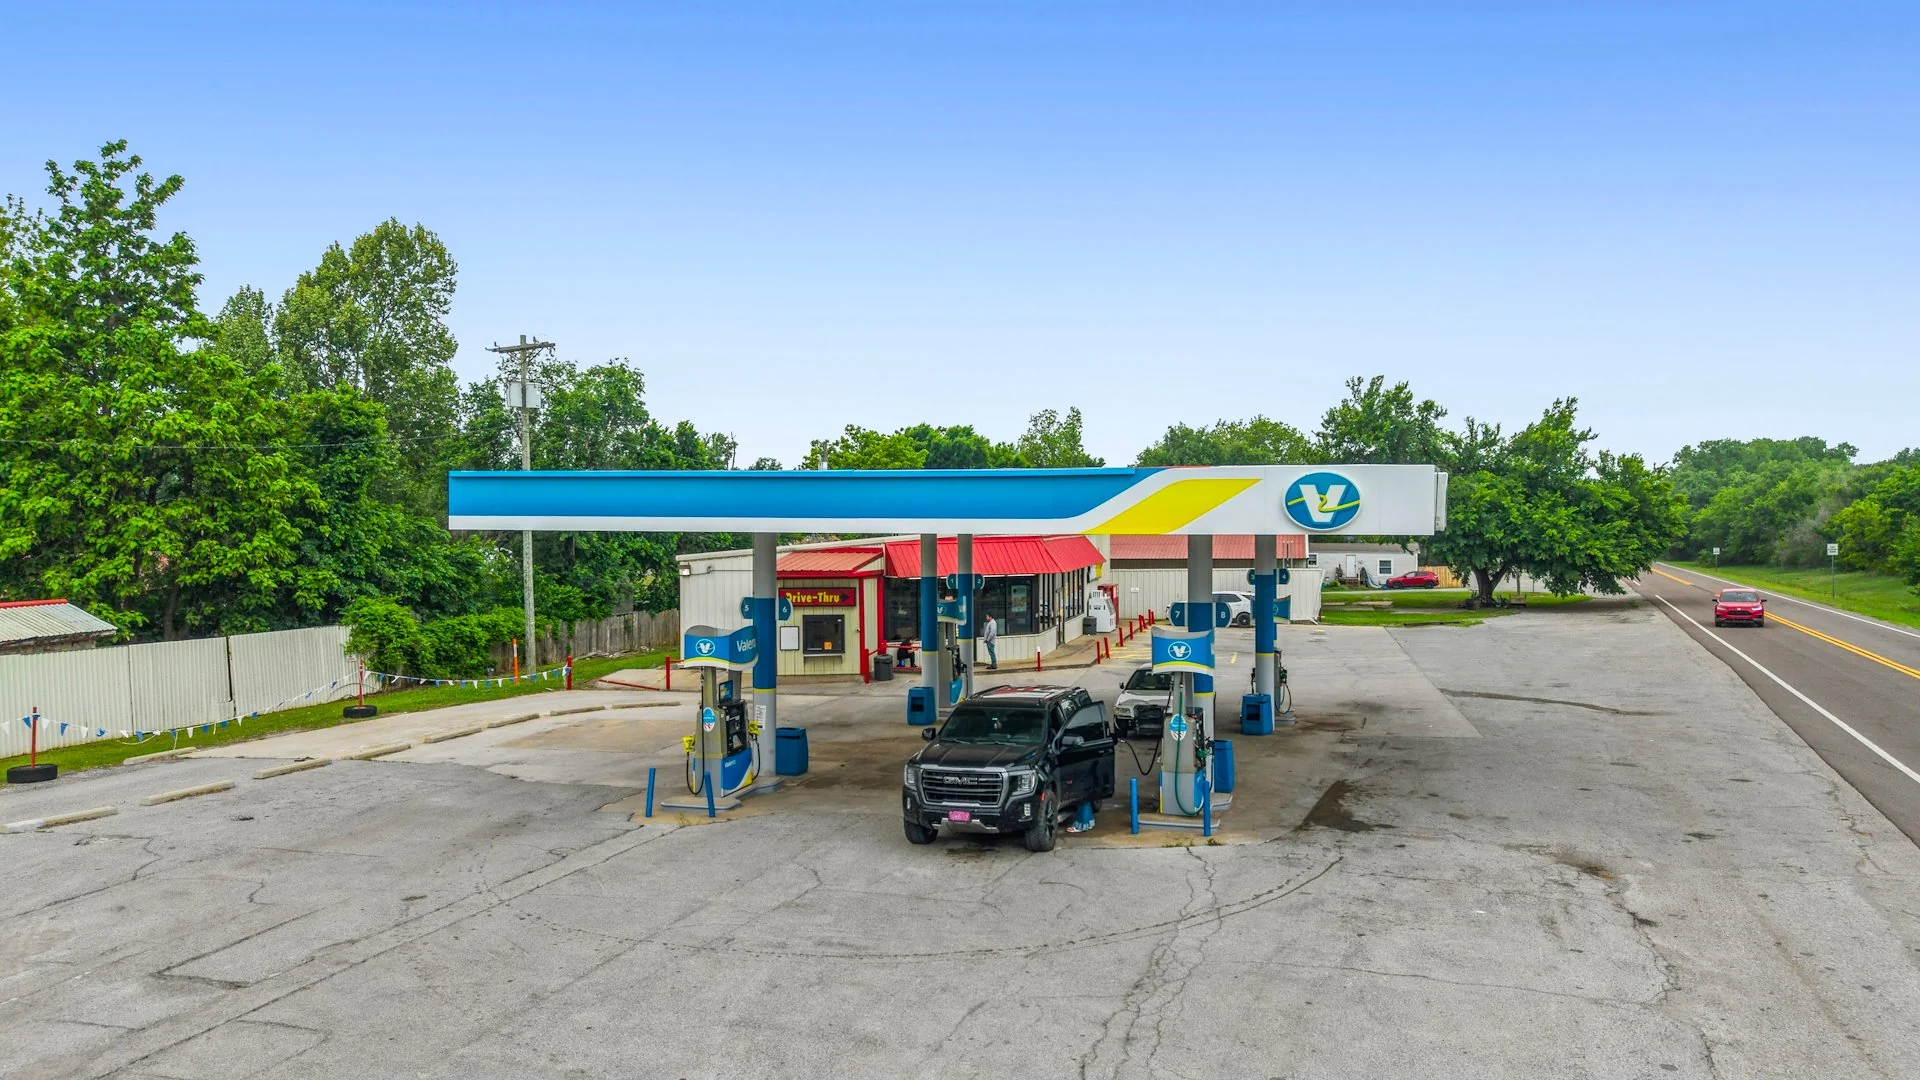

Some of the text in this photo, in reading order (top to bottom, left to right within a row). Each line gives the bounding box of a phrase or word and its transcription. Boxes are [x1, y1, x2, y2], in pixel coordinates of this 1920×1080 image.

[785, 591, 840, 603] Drive-Thru
[1174, 610, 1181, 618] 7
[1220, 611, 1226, 619] 8
[942, 776, 978, 785] GMC
